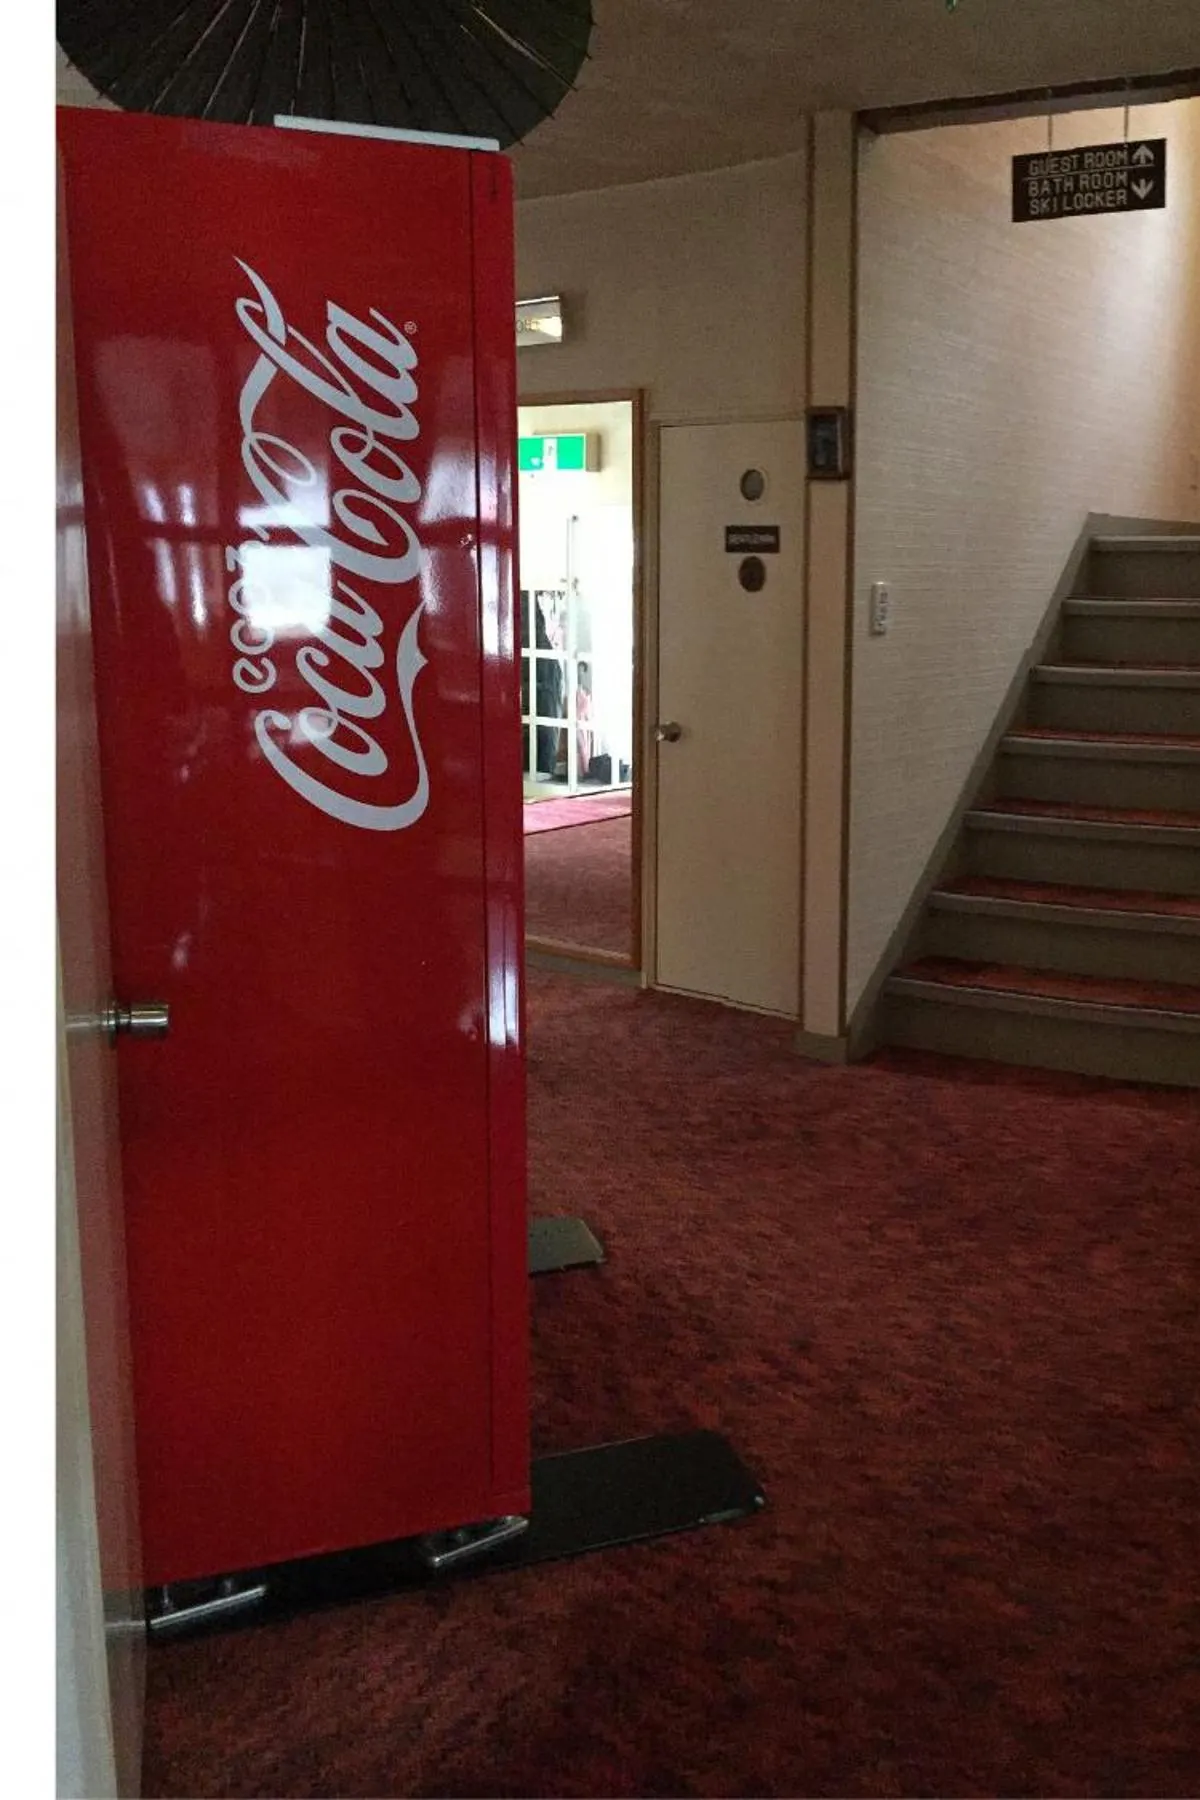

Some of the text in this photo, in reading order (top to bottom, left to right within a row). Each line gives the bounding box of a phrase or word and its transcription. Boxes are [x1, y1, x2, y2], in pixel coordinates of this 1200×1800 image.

[1029, 150, 1128, 176] GUEST ROOM
[1029, 172, 1128, 197] BATH ROOM
[1030, 190, 1128, 215] SKI LOCKER
[232, 255, 430, 832] Coca-Cola
